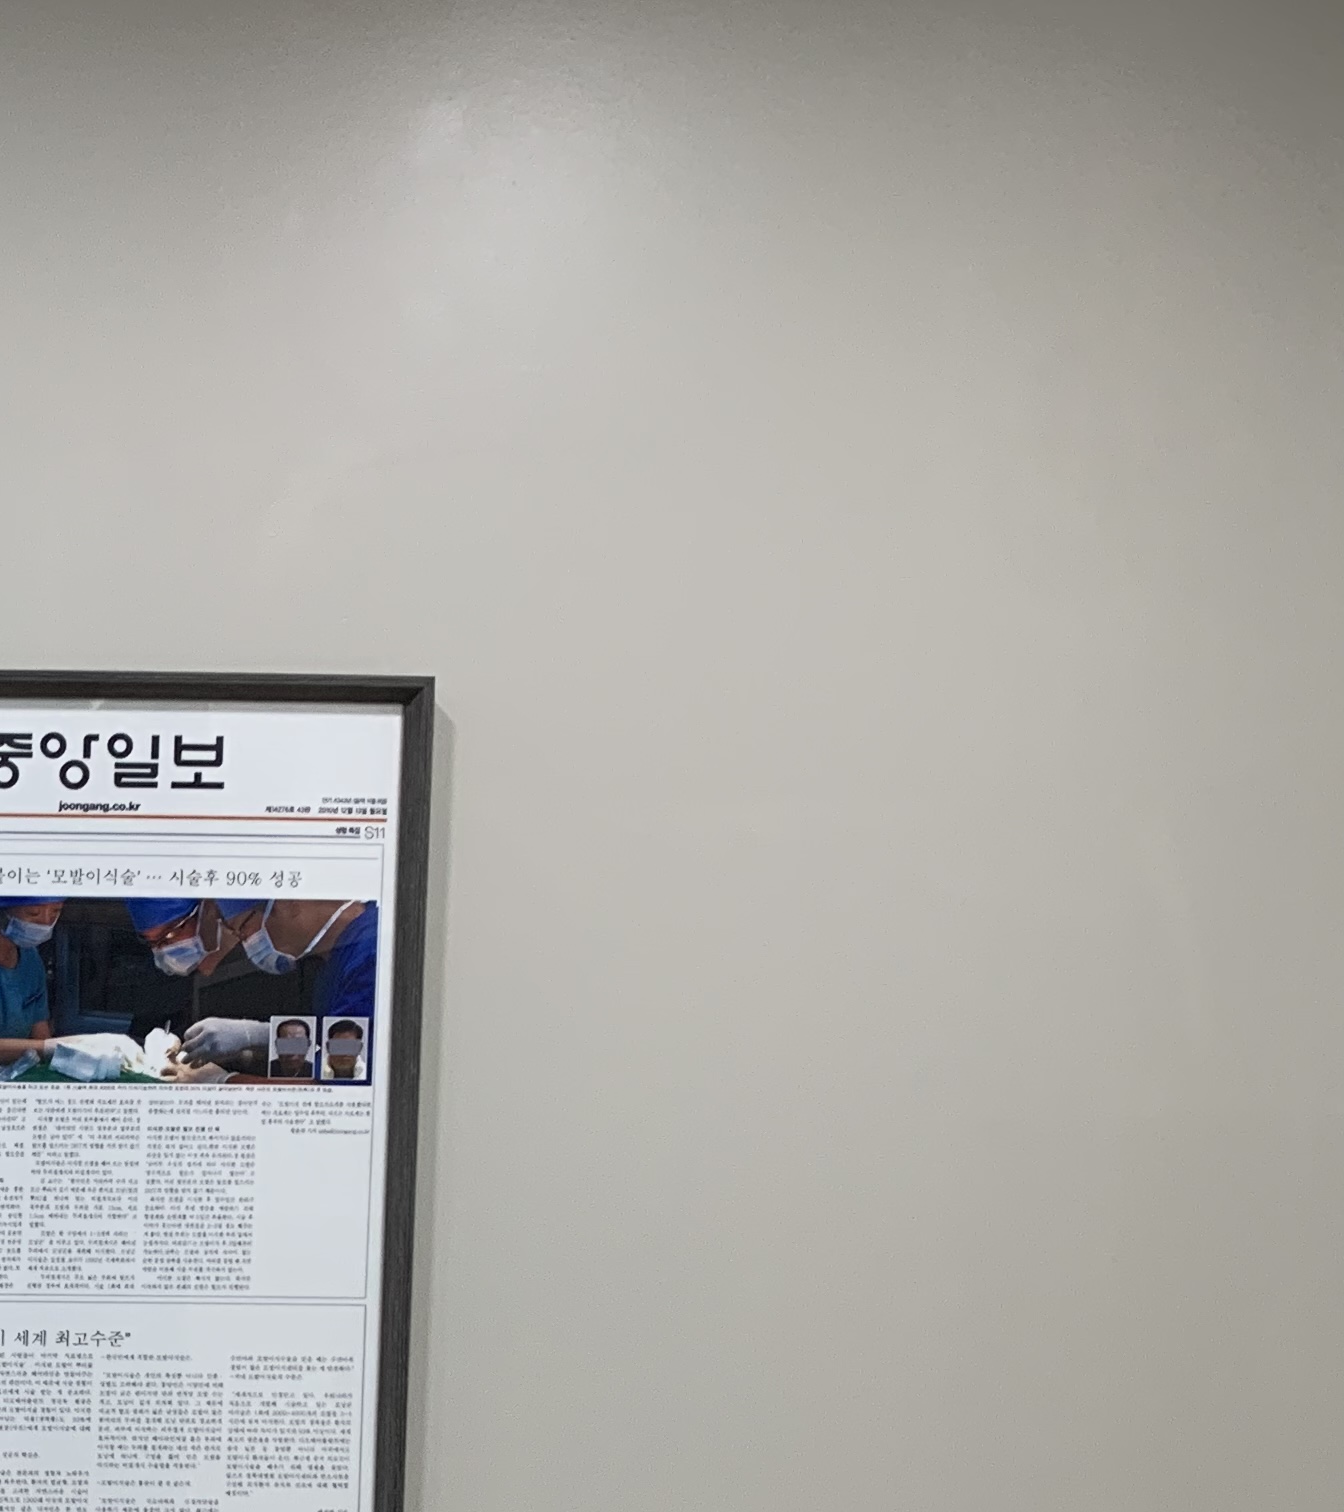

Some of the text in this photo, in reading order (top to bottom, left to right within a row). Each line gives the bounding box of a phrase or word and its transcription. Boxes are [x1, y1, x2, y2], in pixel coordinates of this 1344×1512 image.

[58, 801, 141, 813] joongang.co.kr
[365, 826, 385, 840] S11
[170, 869, 218, 886] 시술후
[227, 872, 261, 886] 90%
[270, 871, 302, 888] 성공
[15, 1330, 46, 1346] 세계
[56, 1330, 131, 1347] 최고수준"
